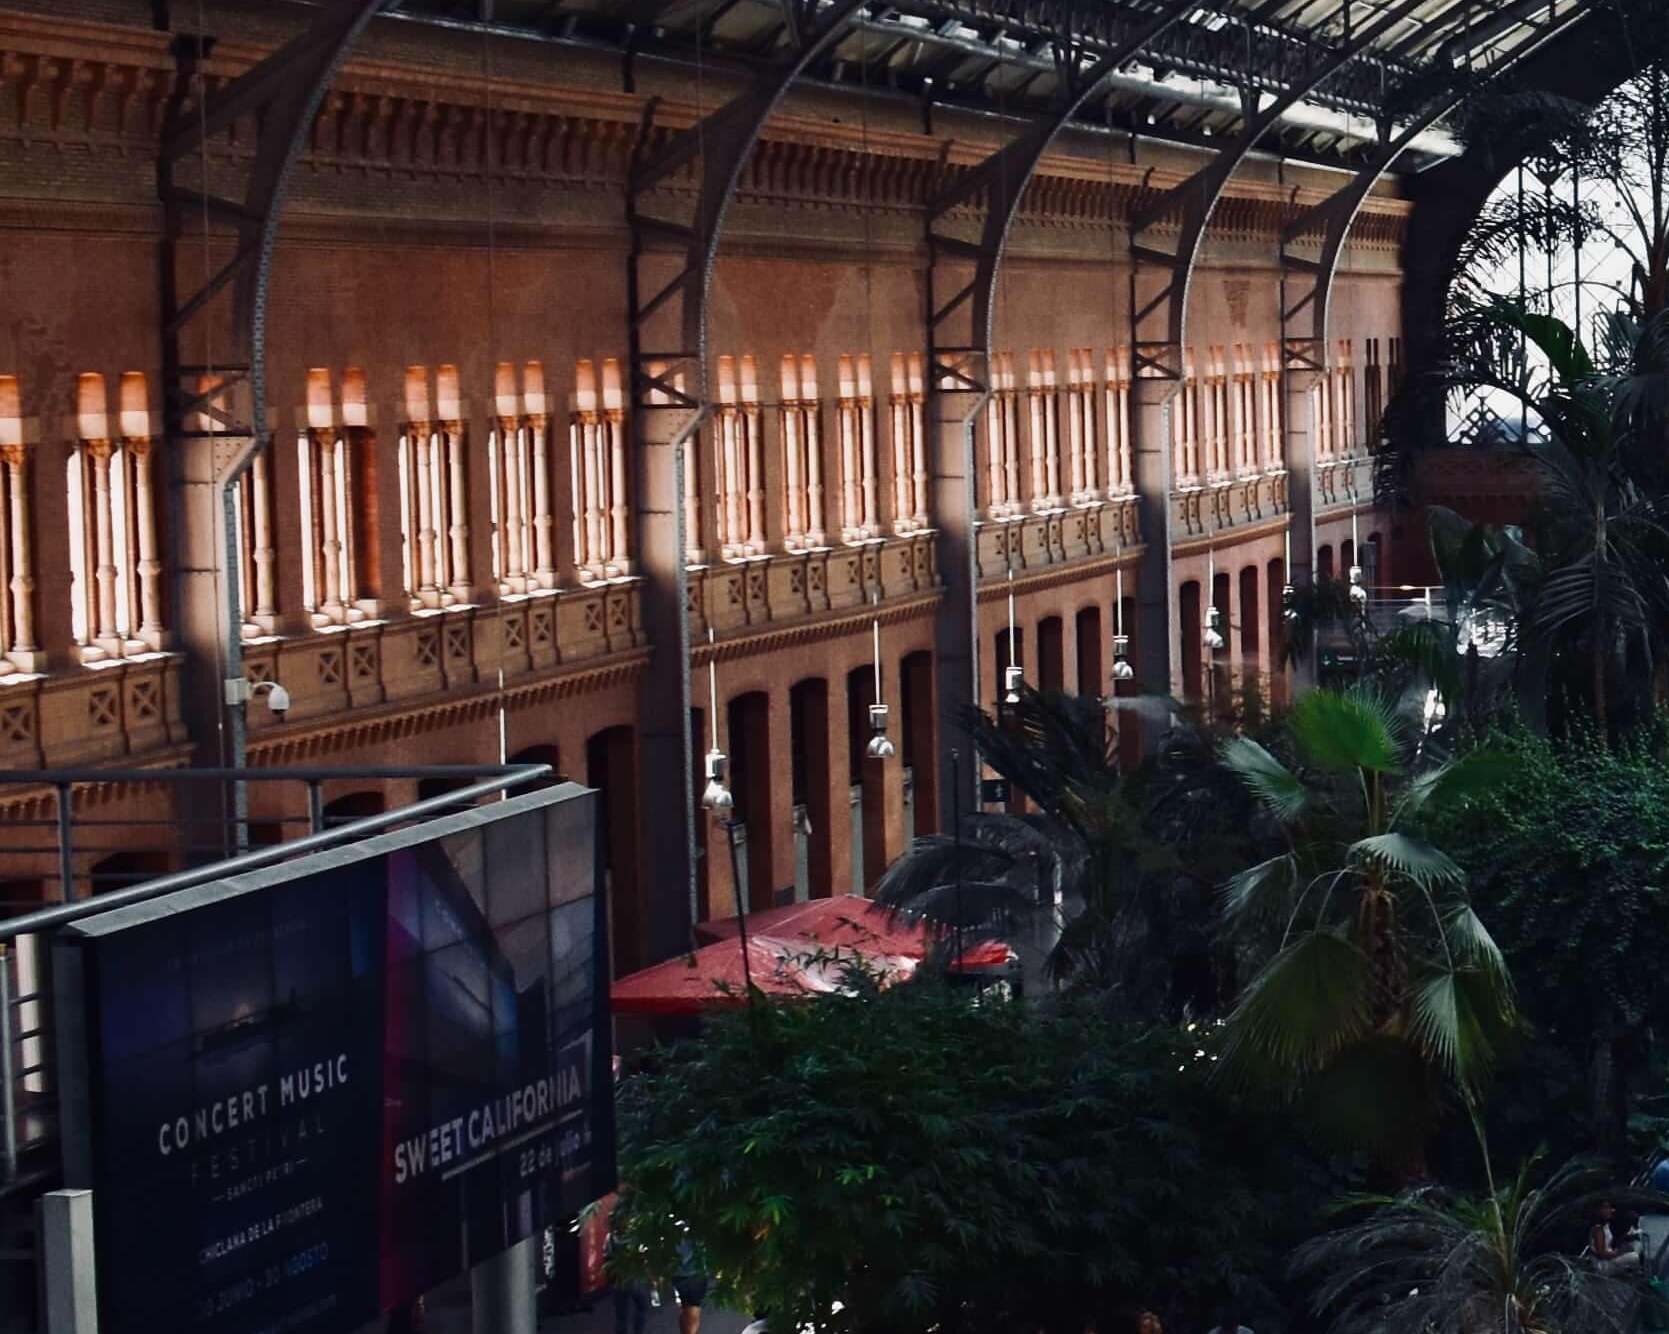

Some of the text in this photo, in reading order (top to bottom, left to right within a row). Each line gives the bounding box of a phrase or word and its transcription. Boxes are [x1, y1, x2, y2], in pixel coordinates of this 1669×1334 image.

[158, 1053, 349, 1156] CONCERT MUSIC
[393, 1065, 582, 1186] SWEET CALIFORNIA
[190, 1108, 328, 1188] FESTIVAL
[519, 1149, 536, 1178] 22
[538, 1141, 553, 1169] de
[247, 1223, 261, 1243] DE
[261, 1217, 275, 1236] LA
